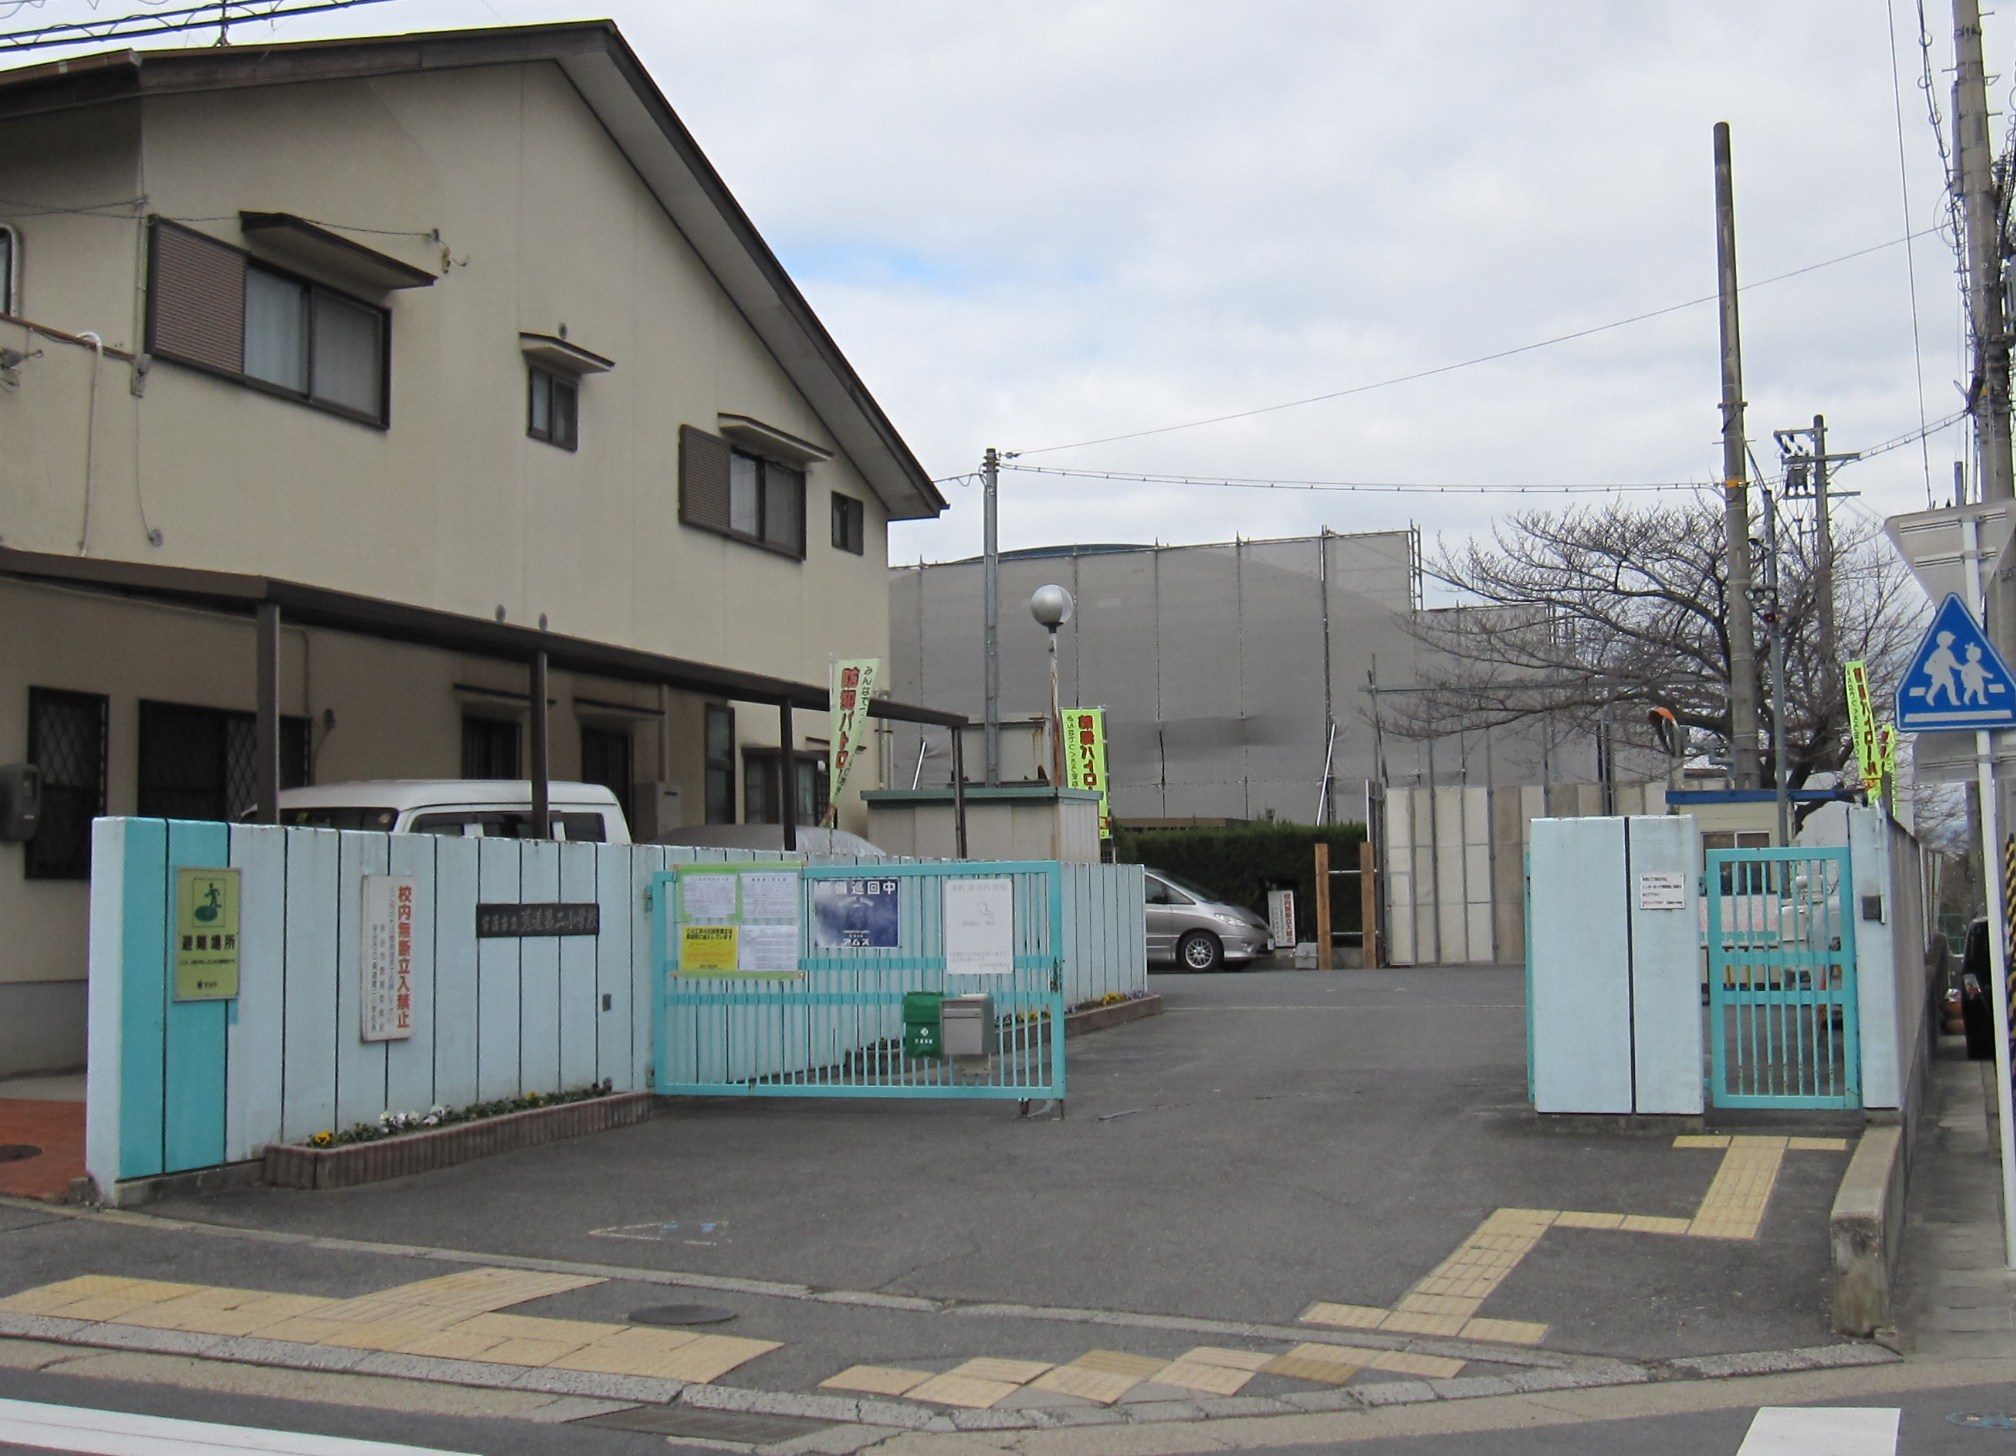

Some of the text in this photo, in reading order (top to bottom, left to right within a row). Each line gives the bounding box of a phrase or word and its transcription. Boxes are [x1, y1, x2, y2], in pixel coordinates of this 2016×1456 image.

[815, 881, 895, 896] 巡回中
[842, 938, 871, 946] アムス
[397, 885, 412, 1029] 校内無断立入禁止
